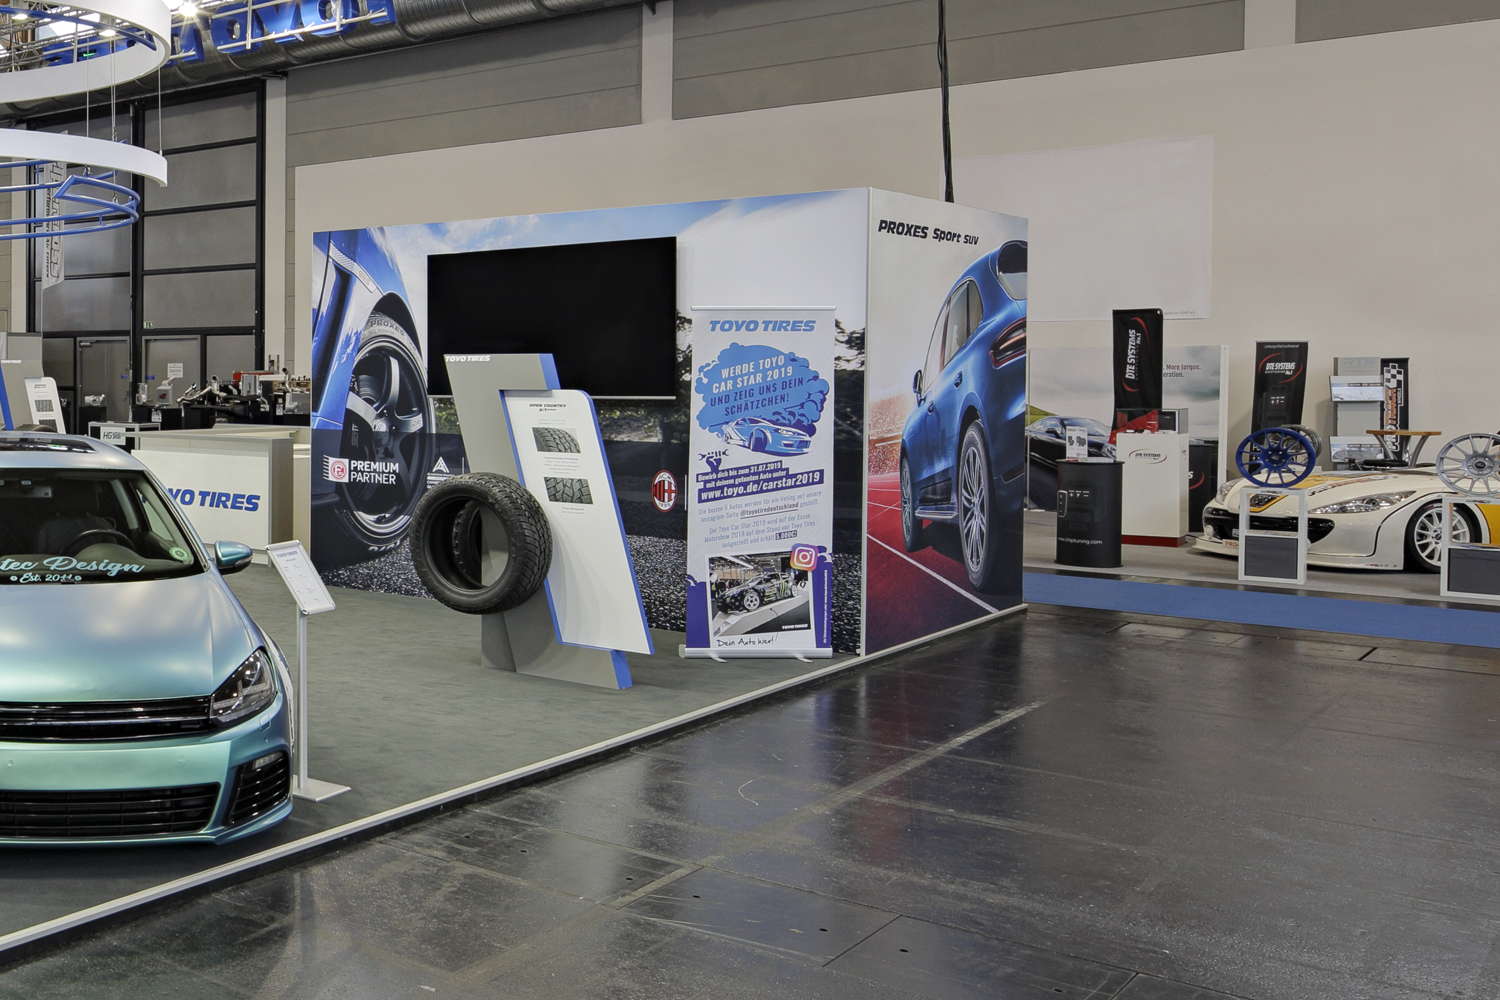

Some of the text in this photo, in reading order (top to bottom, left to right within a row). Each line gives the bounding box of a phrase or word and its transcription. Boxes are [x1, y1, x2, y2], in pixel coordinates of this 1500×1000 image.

[878, 219, 979, 245] PROXES Sport SUV
[370, 319, 405, 337] PROXES
[709, 320, 816, 332] TOYO TIRES
[1125, 329, 1136, 380] DTE SYSTEMS
[721, 355, 785, 379] WERDE TOYO
[1181, 363, 1201, 371] torque.
[1274, 362, 1296, 370] SYSTEMS
[712, 366, 793, 394] CAR STAR 2019
[710, 377, 804, 407] UND ZEIG UNS DEIN
[724, 392, 790, 416] SCHÄTZCHEN!
[1384, 386, 1397, 450] PROTRACK
[350, 460, 399, 473] PREMIUM
[698, 472, 717, 482] Bewirb
[717, 471, 729, 479] dich
[728, 469, 738, 477] bis
[750, 462, 781, 473] 31.07.2019
[350, 472, 397, 485] PARTNER
[701, 471, 820, 500] www.toyo.de/carstar2019
[705, 481, 716, 489] mit
[716, 479, 735, 487] deinem
[734, 475, 759, 485] getunten
[772, 470, 787, 478] unter
[198, 490, 261, 512] TIRES
[700, 511, 739, 523] Instagram-Seite
[740, 502, 798, 517] @toyotiredeutschland
[704, 534, 730, 542] Motorshow
[766, 525, 781, 533] Stand
[722, 539, 749, 548] ausgestellt
[42, 556, 146, 577] Design
[19, 573, 42, 583] Est.
[716, 636, 774, 647] Dein Auto hier!
